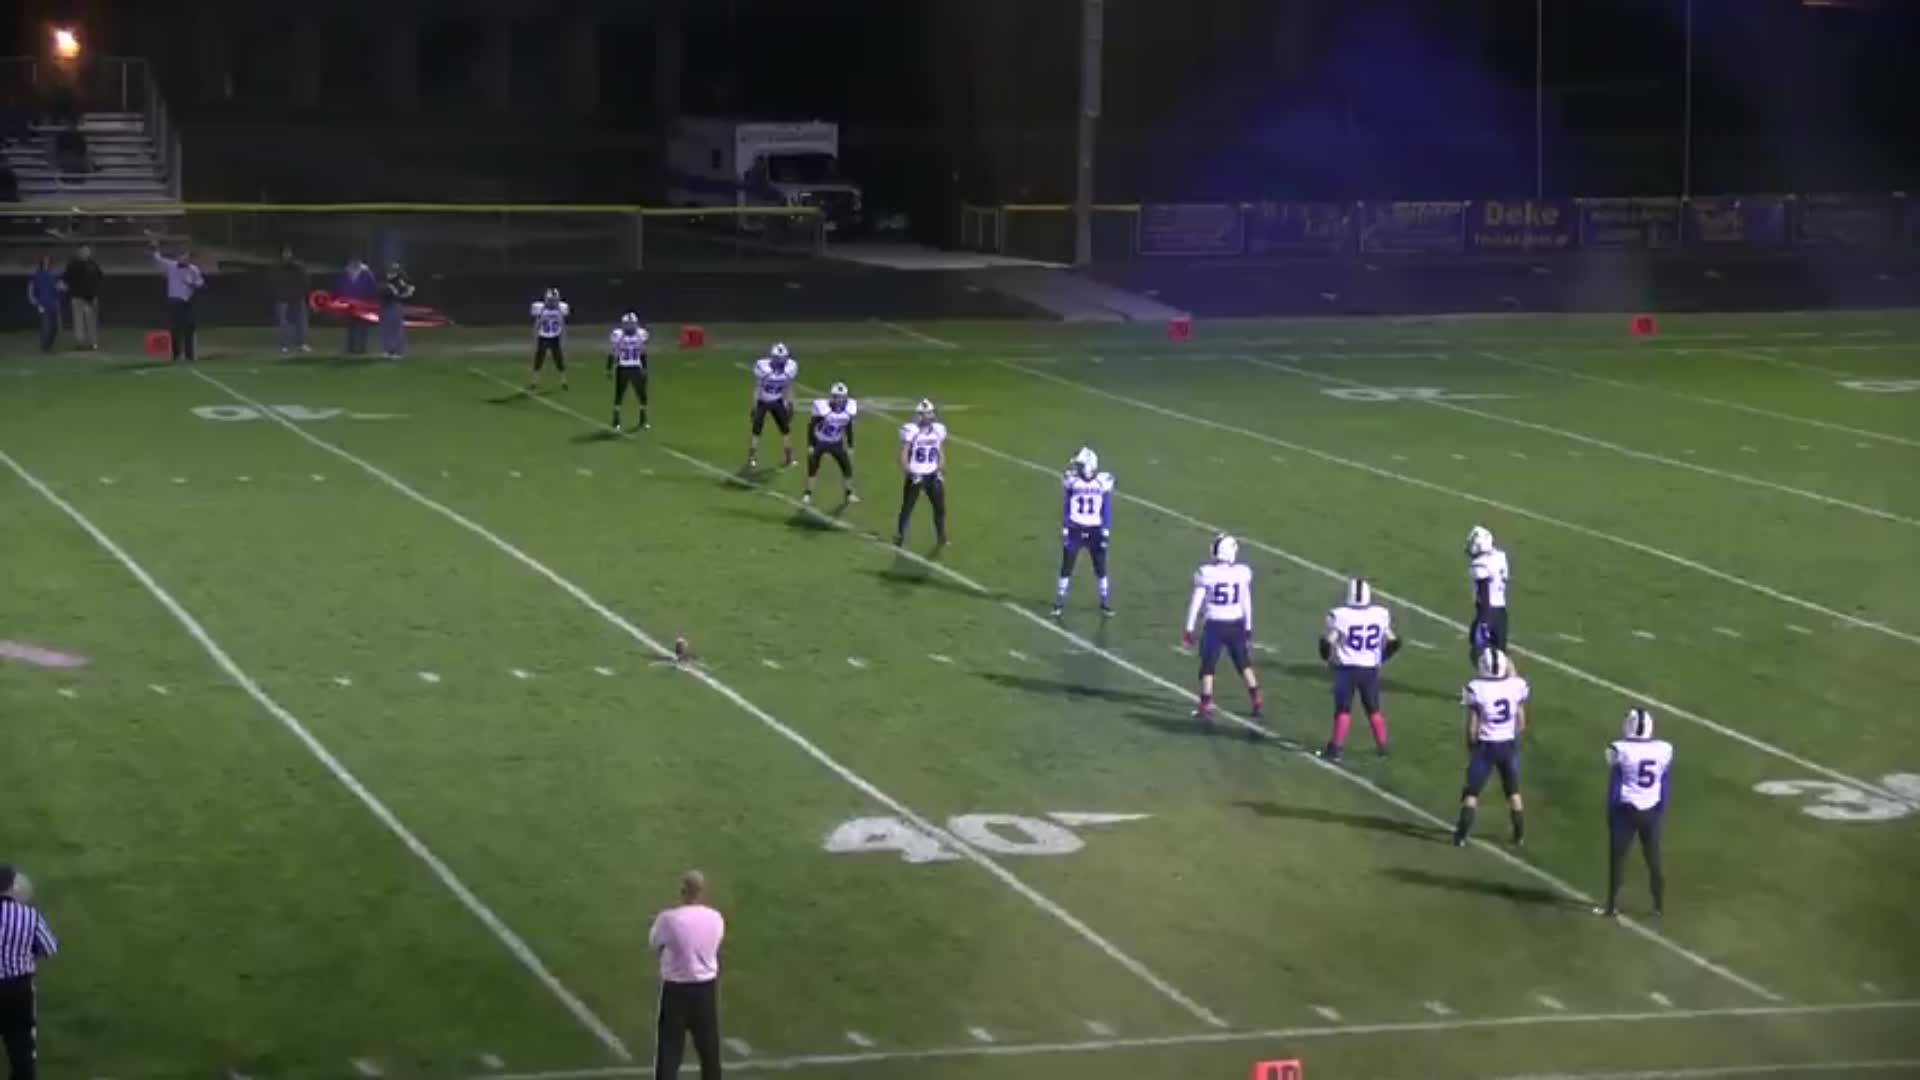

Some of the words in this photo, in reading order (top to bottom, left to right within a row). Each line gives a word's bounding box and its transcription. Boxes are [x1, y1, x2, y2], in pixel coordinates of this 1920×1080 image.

[1486, 200, 1560, 226] Deke
[1077, 497, 1095, 514] 11
[1213, 582, 1240, 606] 51
[1492, 699, 1511, 724] 3
[1637, 760, 1657, 788] 5
[824, 813, 1086, 863] 40
